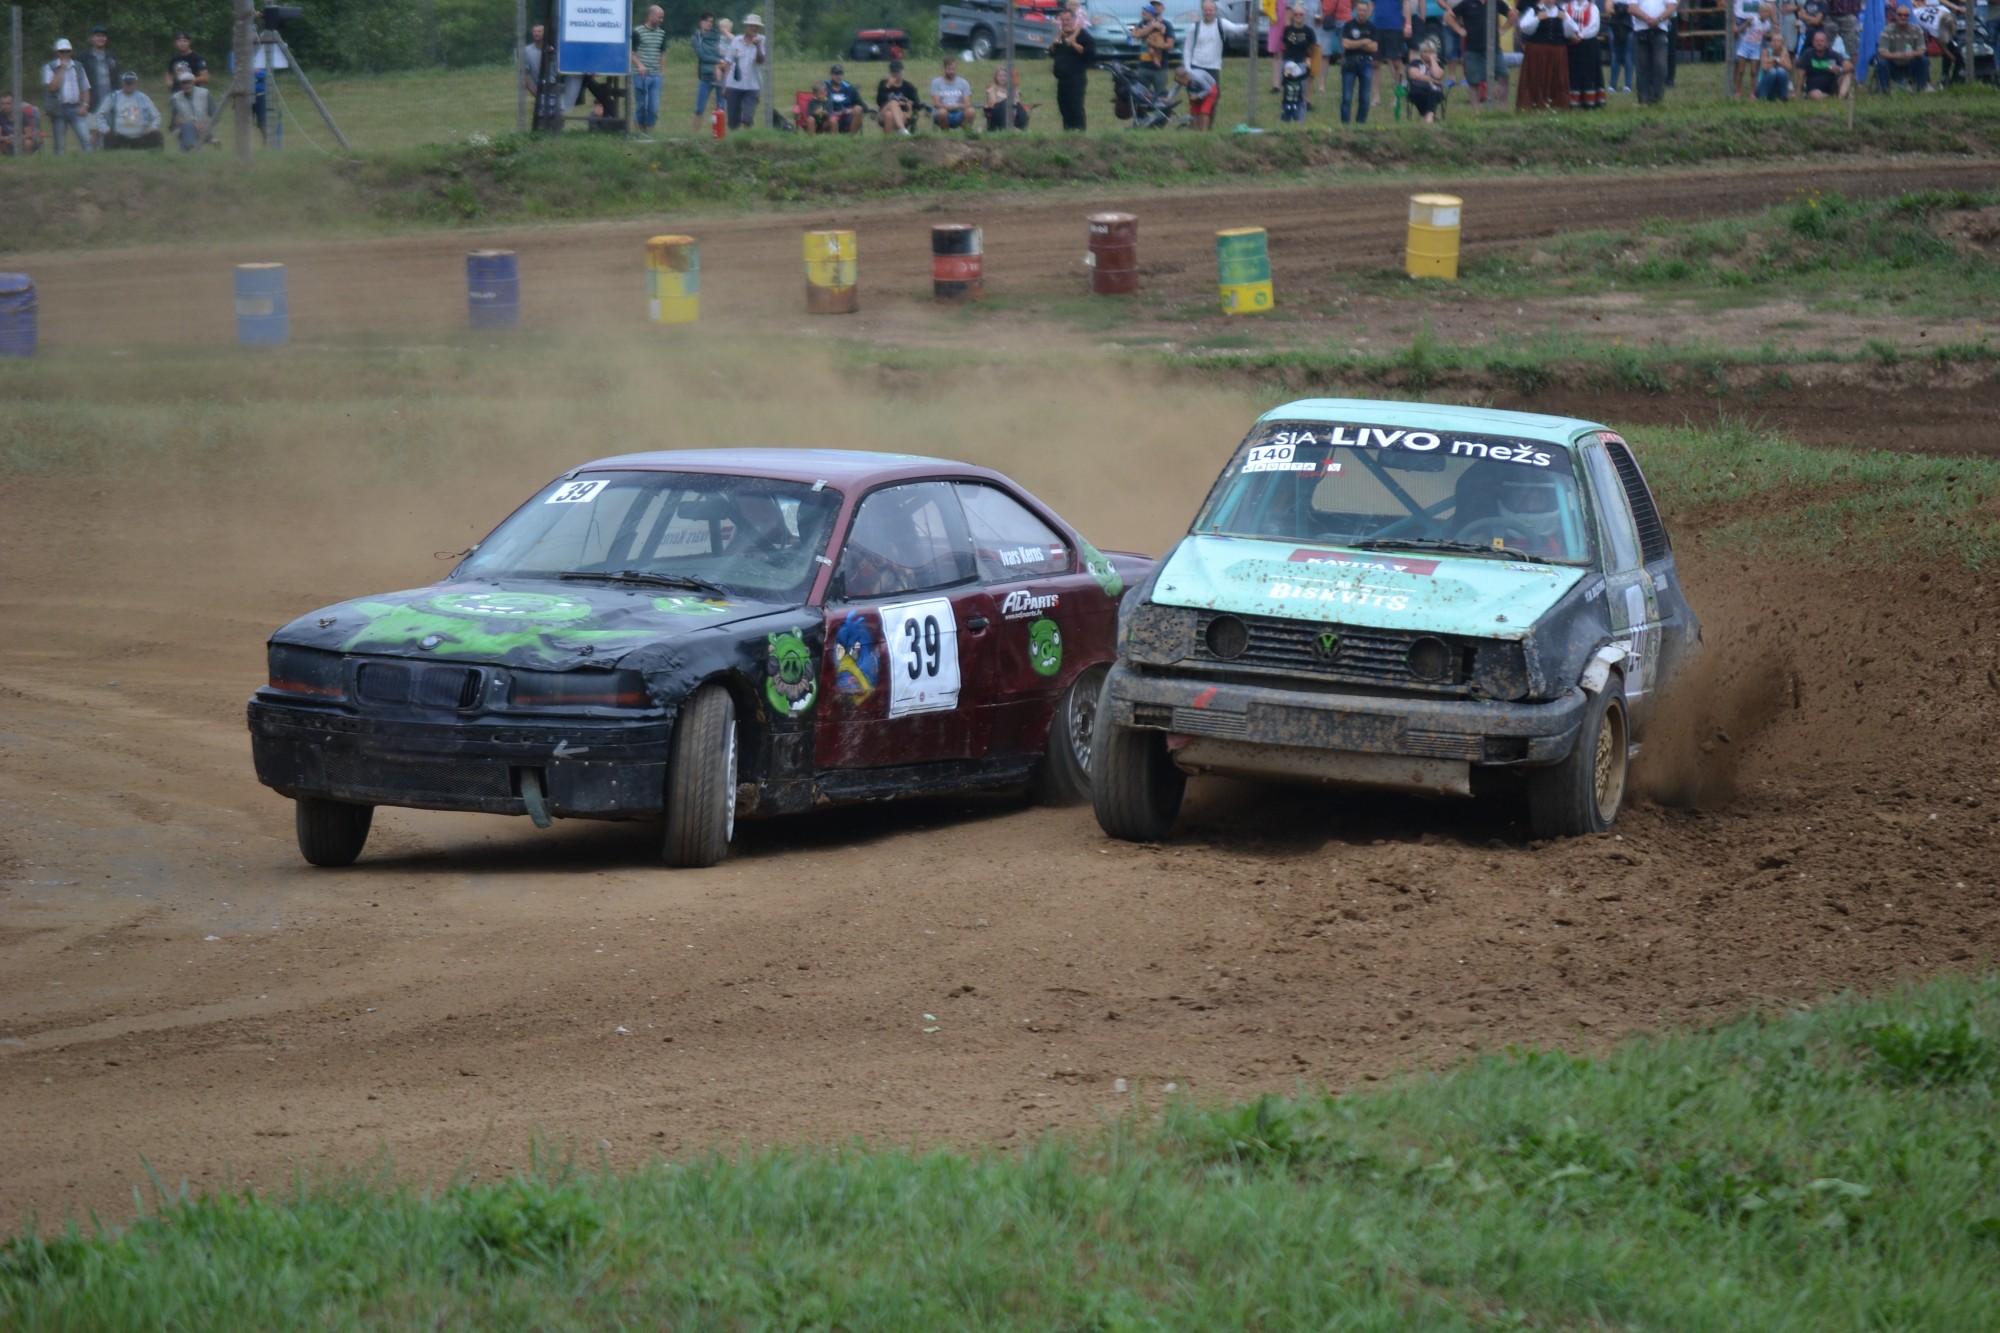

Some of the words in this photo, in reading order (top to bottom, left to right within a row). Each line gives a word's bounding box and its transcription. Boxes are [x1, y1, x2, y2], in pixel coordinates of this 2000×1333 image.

[1250, 448, 1291, 462] 140
[1274, 431, 1317, 445] SIA
[1330, 426, 1440, 451] LIVO
[1451, 440, 1551, 467] mežs
[1243, 463, 1315, 473] KAVITA
[556, 481, 599, 502] 39
[1000, 548, 1022, 567] Ivars
[1019, 546, 1044, 565] Kerns
[904, 614, 941, 680] 39
